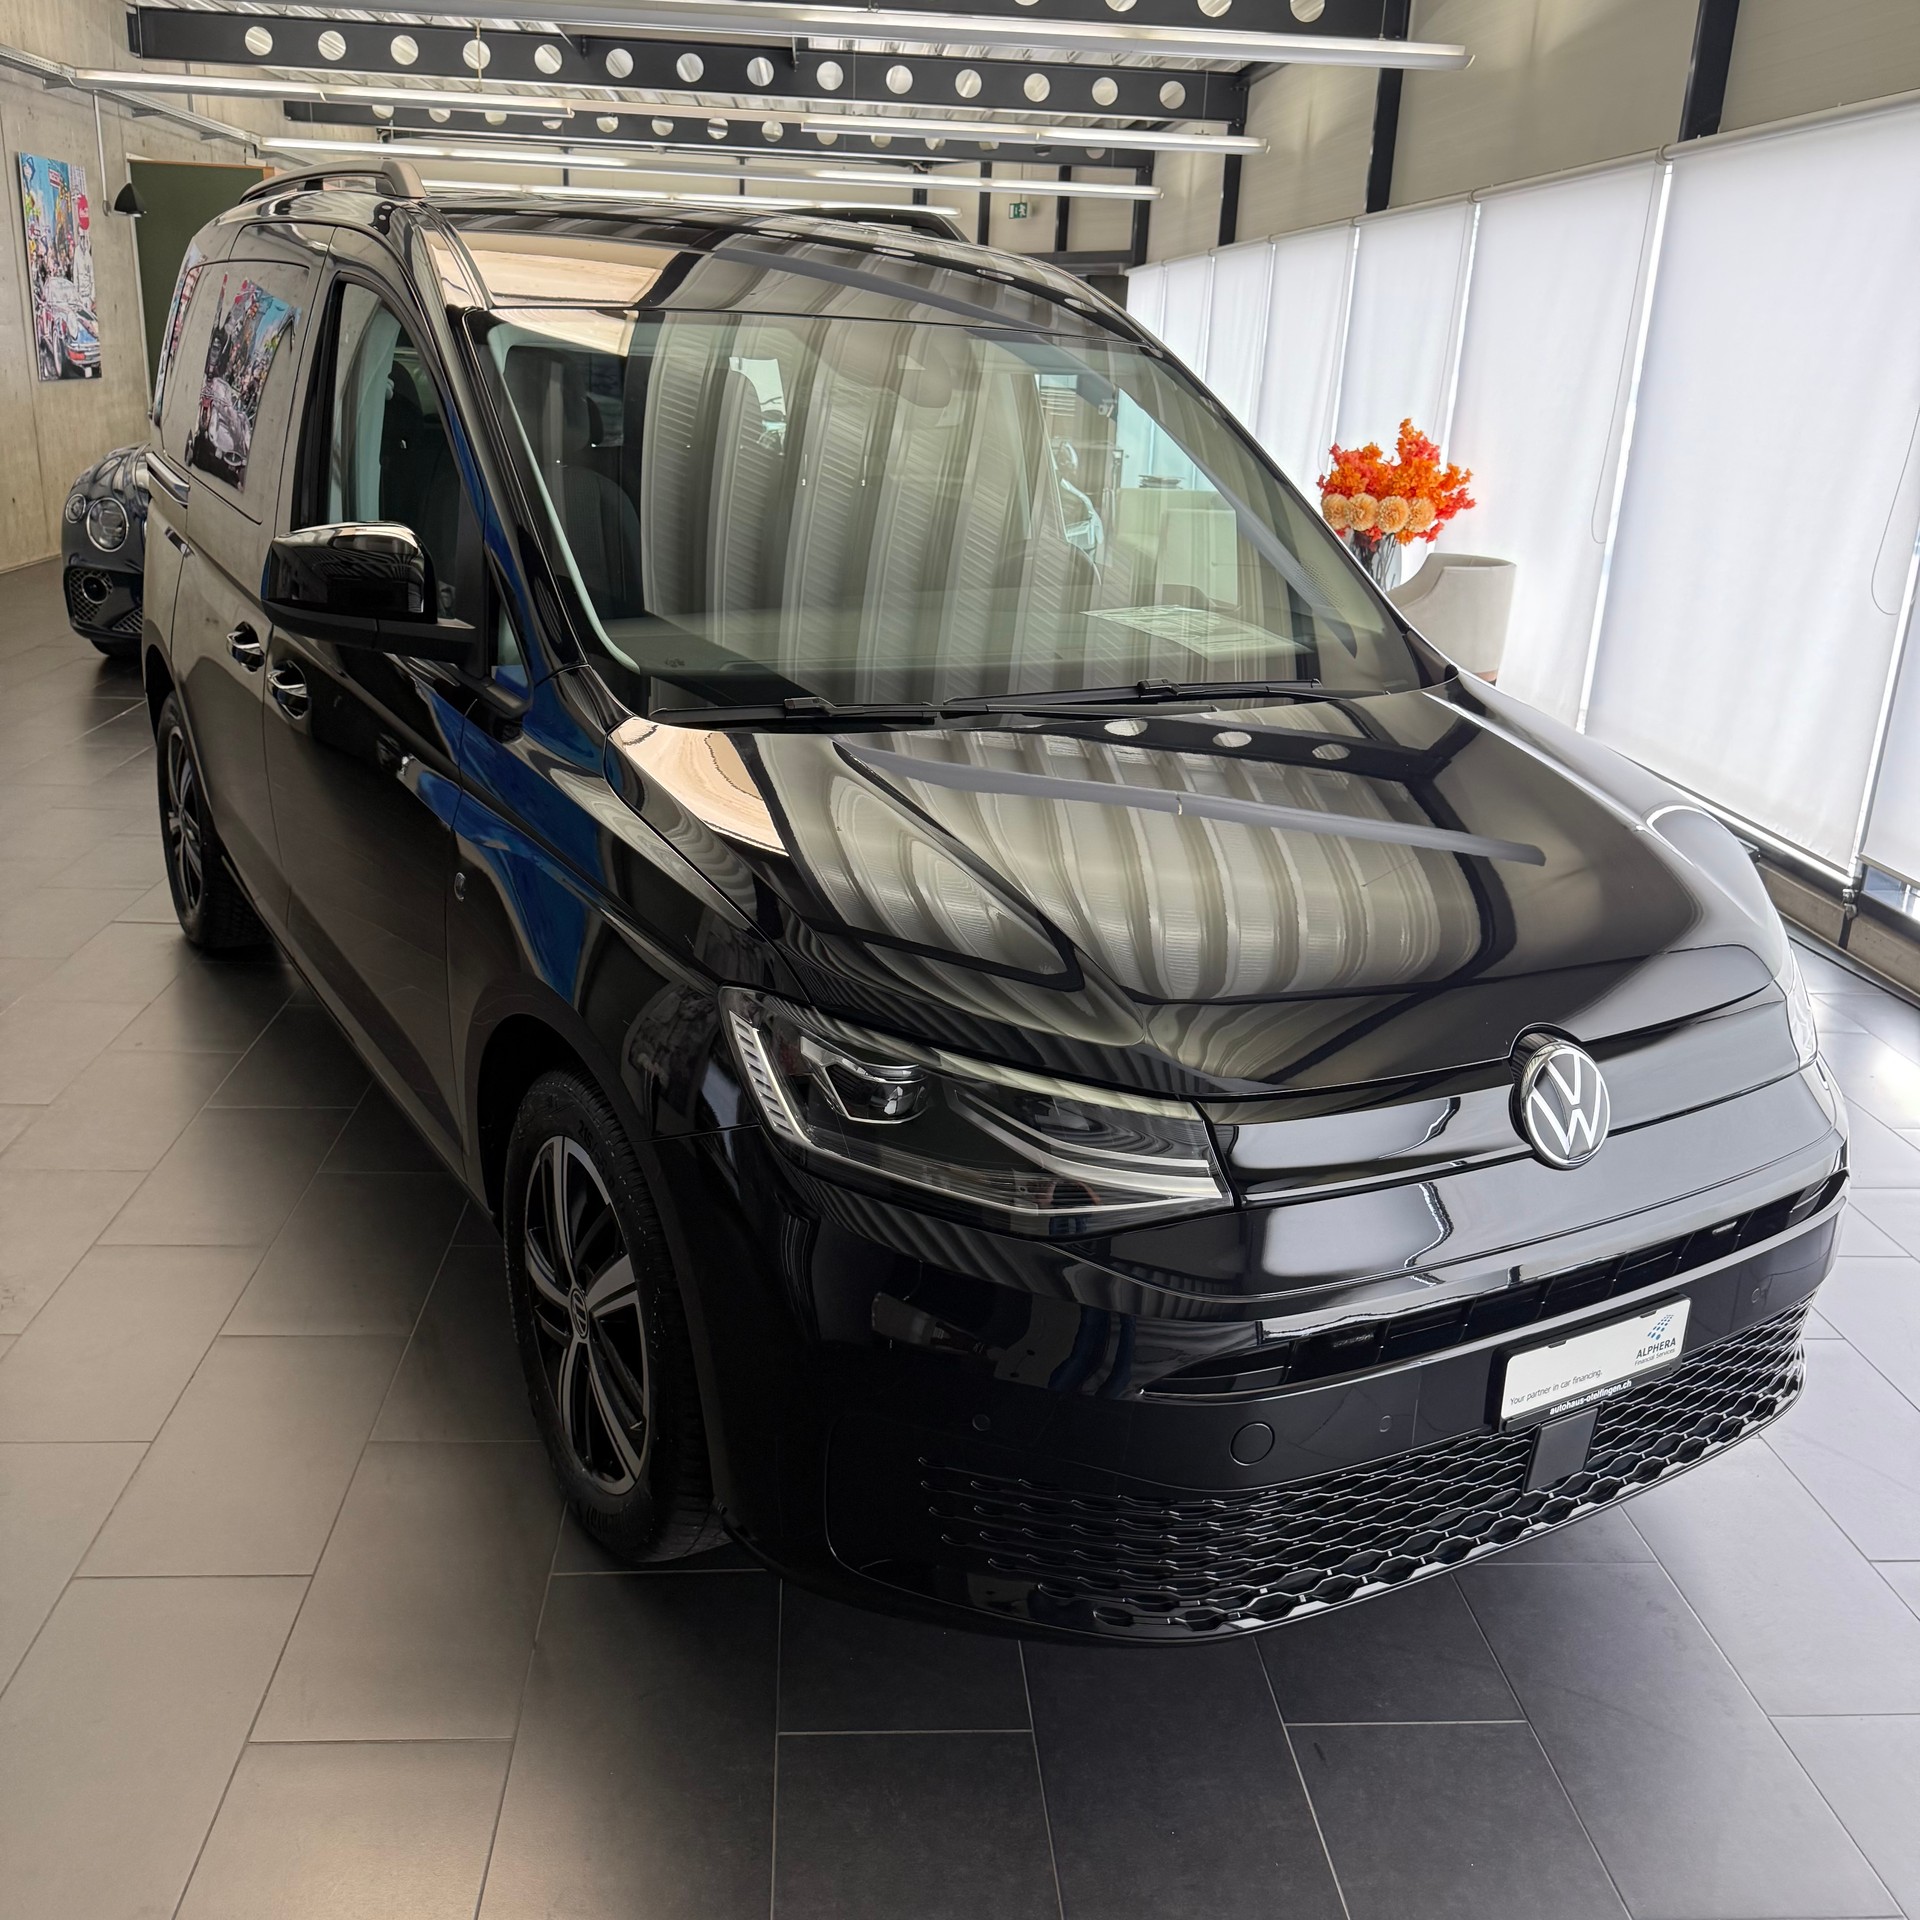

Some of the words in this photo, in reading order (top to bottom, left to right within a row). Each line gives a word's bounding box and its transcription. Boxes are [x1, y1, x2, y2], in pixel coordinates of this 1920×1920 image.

[1634, 1355, 1655, 1366] Financial
[1655, 1348, 1675, 1359] Services
[1636, 1337, 1676, 1359] ALPHERA
[1509, 1395, 1525, 1405] Your
[1526, 1385, 1552, 1401] partner
[1552, 1383, 1560, 1391] in
[1560, 1379, 1571, 1388] car
[1572, 1369, 1603, 1385] financing.
[1549, 1379, 1632, 1415] autohaus-otelfingen.ch
